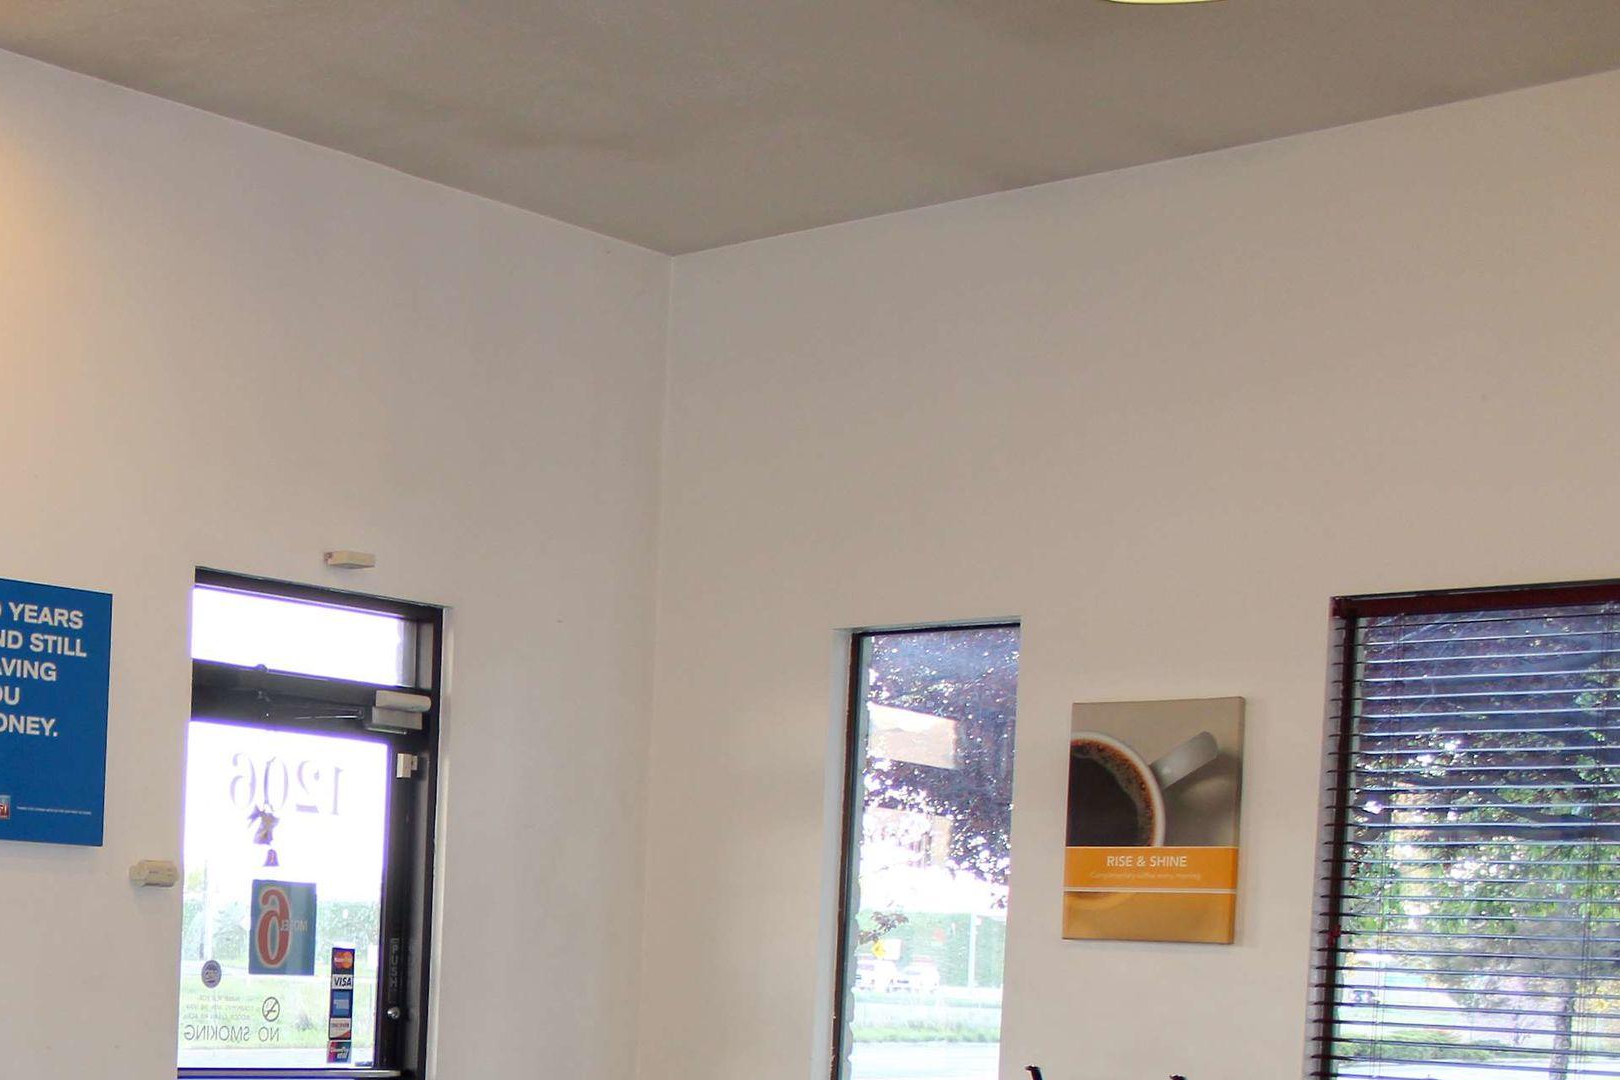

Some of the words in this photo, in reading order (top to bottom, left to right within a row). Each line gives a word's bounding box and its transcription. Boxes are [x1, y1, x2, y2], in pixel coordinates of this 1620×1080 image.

[8, 602, 84, 630] YEARS
[30, 633, 88, 658] STILL
[1106, 855, 1133, 867] RISE
[1136, 855, 1146, 867] &
[1149, 855, 1188, 868] SHINE
[334, 977, 352, 987] VISA
